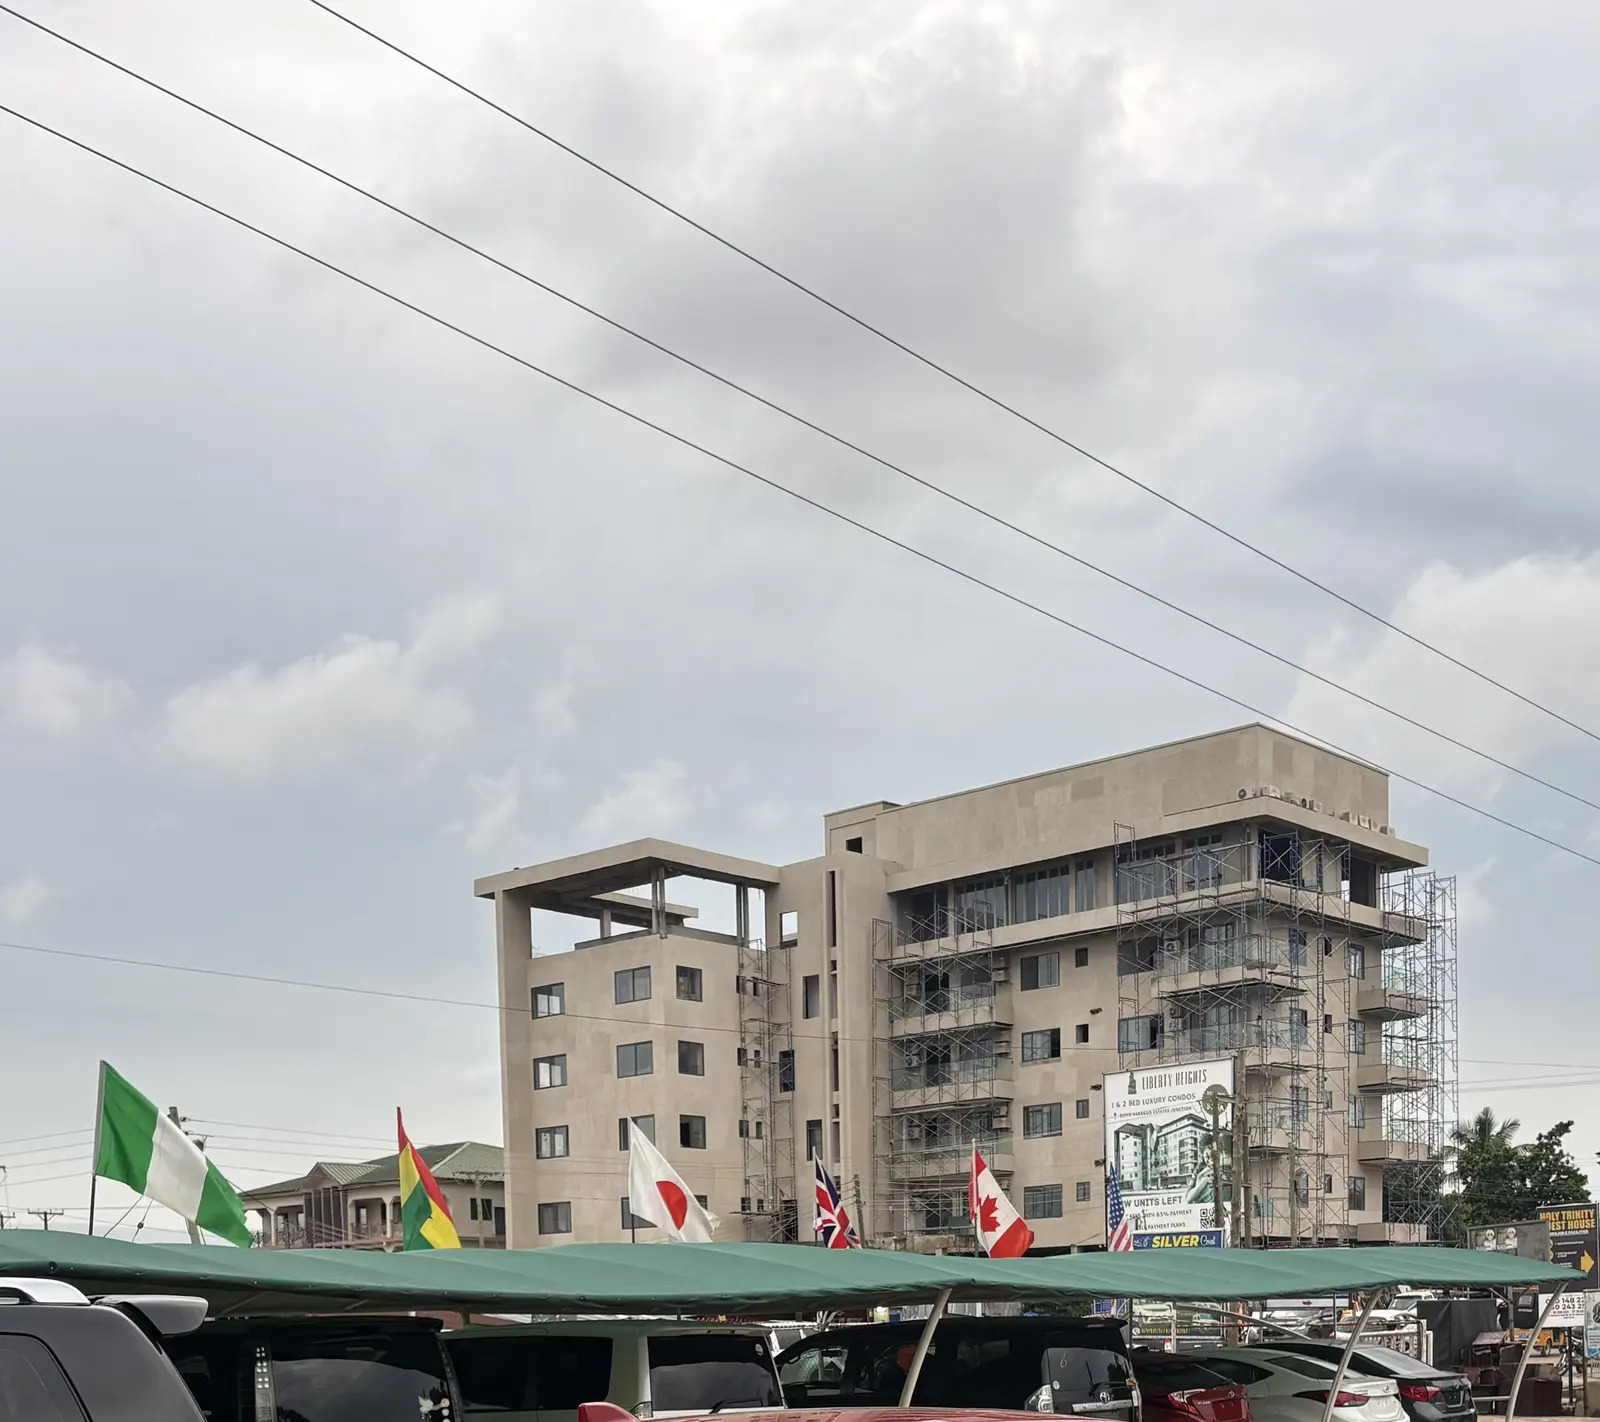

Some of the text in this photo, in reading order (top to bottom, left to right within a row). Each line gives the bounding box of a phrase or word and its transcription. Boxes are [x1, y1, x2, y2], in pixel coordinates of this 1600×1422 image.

[1142, 1069, 1207, 1090] LIBERTY HEIGHTS
[1128, 1099, 1141, 1107] BED
[1142, 1096, 1167, 1105] LUXURY
[1167, 1093, 1196, 1102] CONDOS
[1133, 1197, 1160, 1208] UNITS
[1162, 1195, 1183, 1205] LEFT
[1540, 1208, 1595, 1221] HOLY TRINITY
[1147, 1222, 1170, 1230] PAYMENT
[1567, 1218, 1596, 1230] HOUSE
[1151, 1234, 1200, 1249] SILVER
